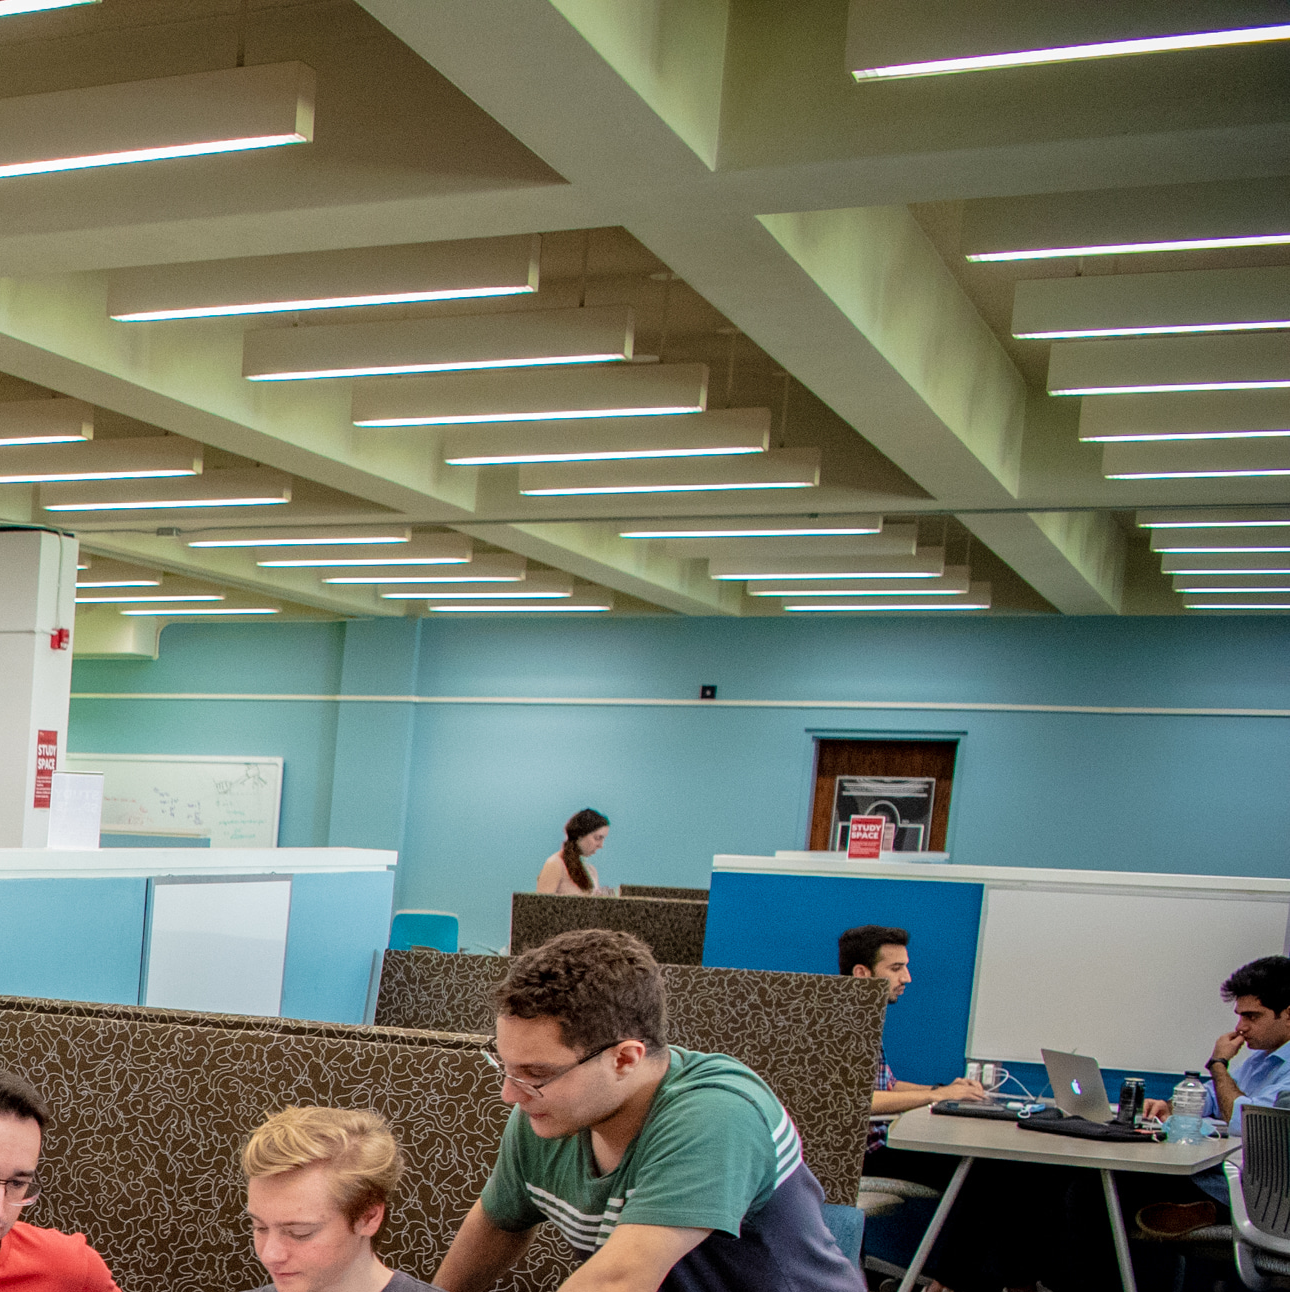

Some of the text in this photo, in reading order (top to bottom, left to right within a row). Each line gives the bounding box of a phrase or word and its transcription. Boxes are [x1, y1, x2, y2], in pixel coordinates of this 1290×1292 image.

[38, 744, 57, 757] STUDY
[37, 758, 55, 770] SPACE
[852, 824, 881, 832] STUDY
